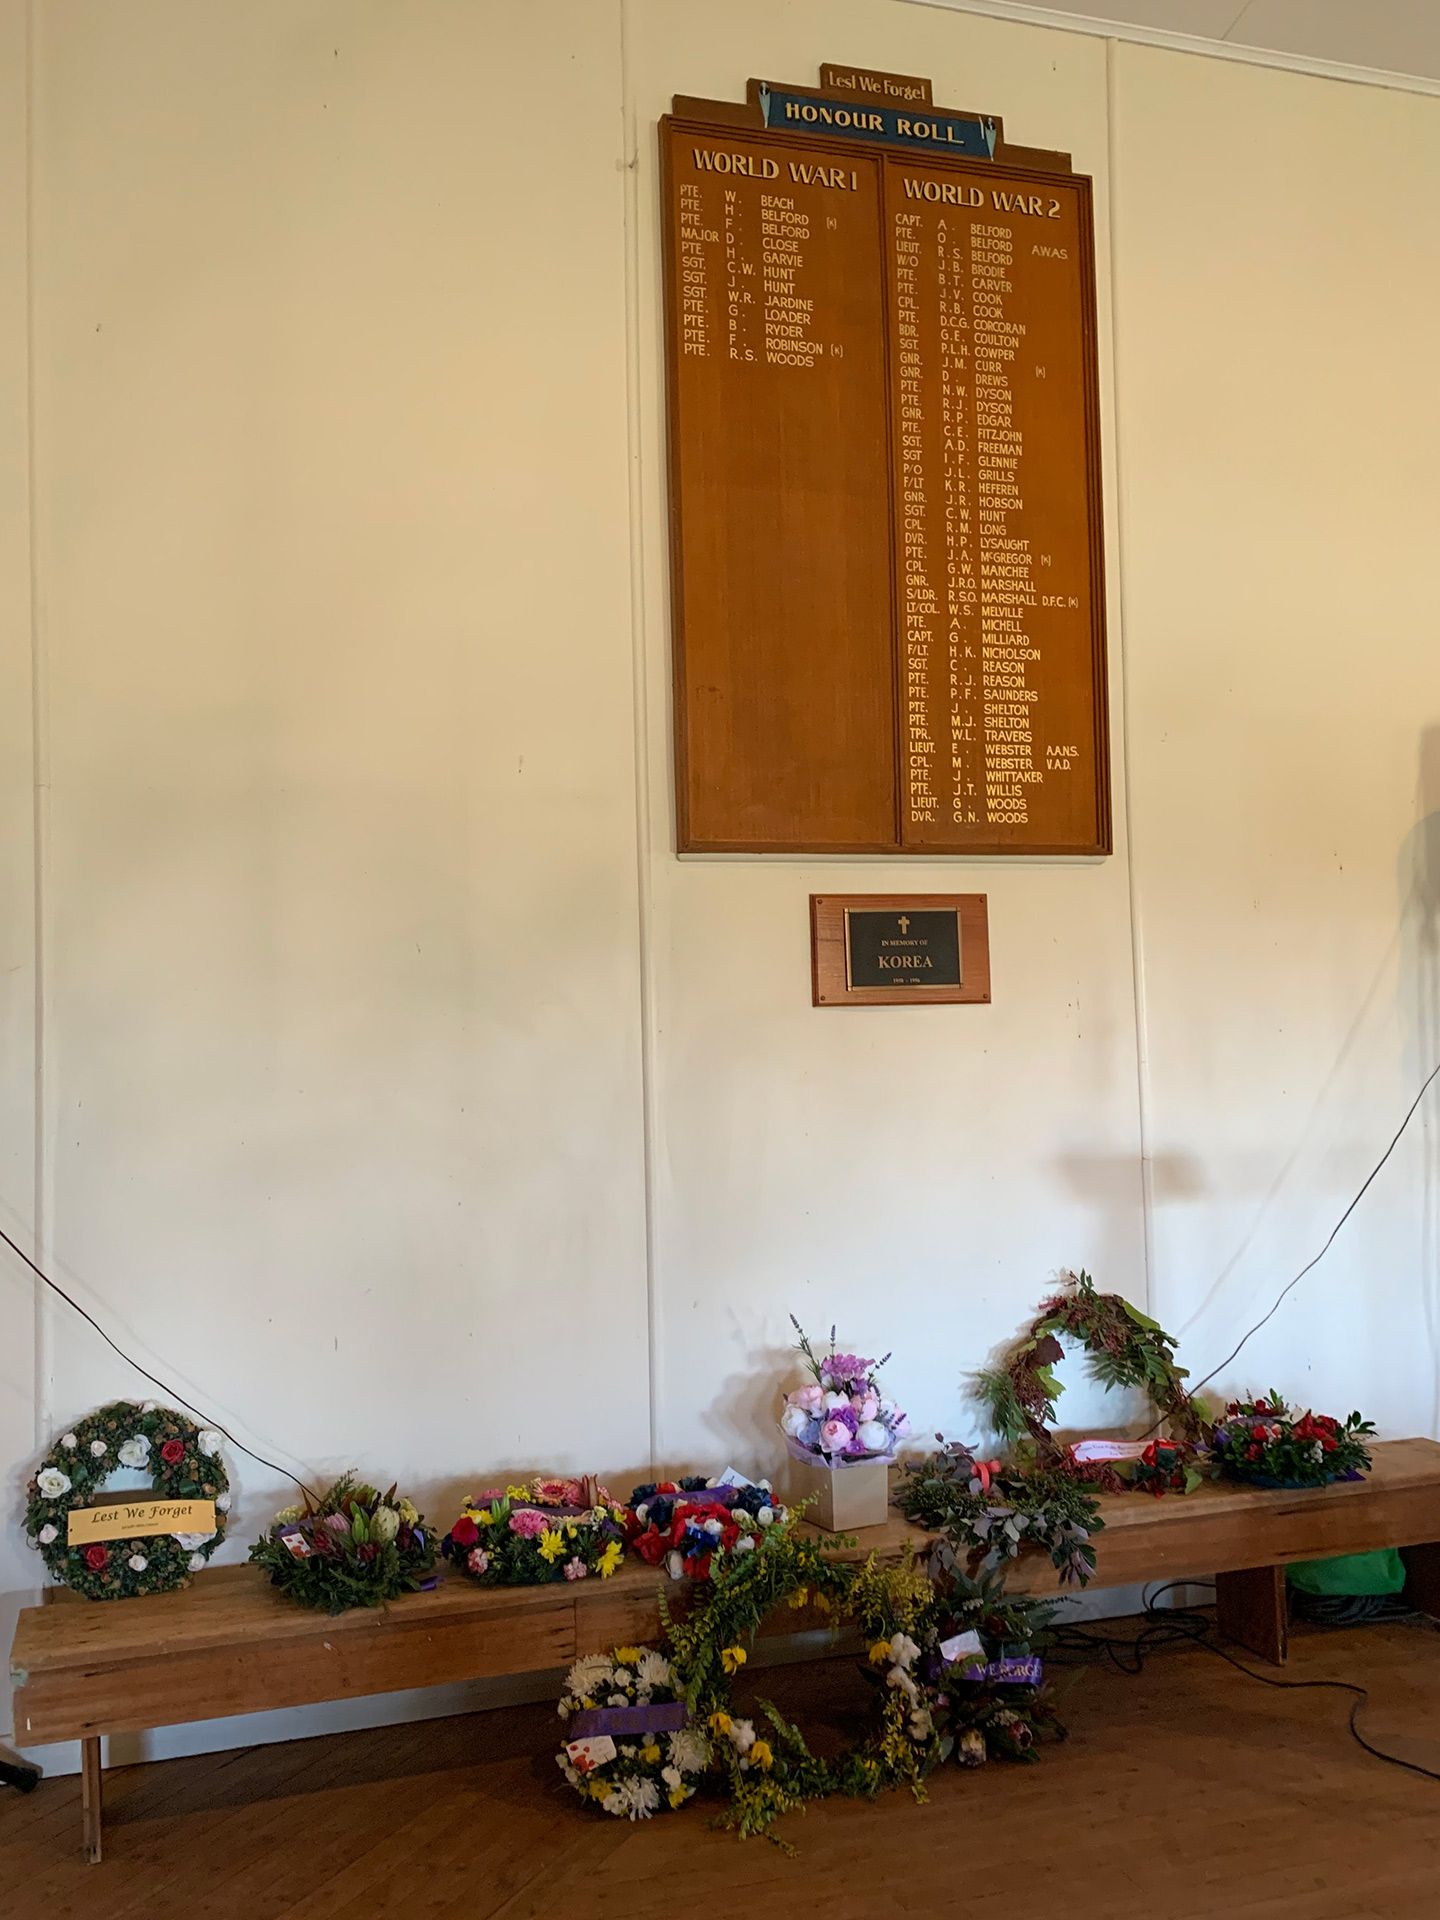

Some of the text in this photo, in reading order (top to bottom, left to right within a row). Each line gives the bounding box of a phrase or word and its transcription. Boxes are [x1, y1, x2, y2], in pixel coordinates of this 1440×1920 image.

[828, 71, 926, 101] Lest We Forget
[785, 101, 965, 145] HONOUR ROLL
[693, 148, 779, 180] WORLD
[789, 162, 846, 190] WAR
[760, 194, 794, 210] BEACH
[903, 178, 1061, 219] WORLD WAR 2
[761, 209, 809, 225] BELFORD
[762, 223, 810, 240] BELFORD
[970, 223, 1012, 239] BELFORD
[681, 227, 799, 253] MAJOR CLOSE
[971, 236, 1013, 252] BELFORD
[763, 252, 803, 268] GARVIE
[971, 250, 1013, 265] BELFORD
[763, 266, 795, 280] HUNT
[897, 254, 1006, 279] W/O BRODIE
[764, 280, 796, 295] HUNT
[972, 277, 1013, 293] CARVER
[765, 296, 814, 311] JARDINE
[973, 292, 1003, 306] COOK
[765, 309, 811, 325] LOADER
[973, 305, 1003, 319] COOK
[765, 323, 804, 338] RYDER
[973, 319, 1026, 335] CORCORAN
[766, 337, 823, 355] ROBINSON
[974, 333, 1019, 348] COULTON
[766, 352, 814, 367] WOODS
[975, 347, 1015, 361] COWPER
[975, 360, 1002, 373] CURR
[975, 373, 1008, 387] DREWS
[975, 387, 1012, 401] DYSON
[976, 402, 1012, 415] DYSON
[977, 414, 1012, 428] EDGAR
[977, 428, 1022, 442] FITZJOHN
[978, 442, 1022, 456] FREEMAN
[903, 449, 1018, 469] SGT GLENNIE
[903, 464, 1015, 482] P/O GRILLS
[903, 476, 1019, 496] F/LT HEFEREN
[979, 497, 1023, 510] HOBSON
[979, 510, 1006, 523] HUNT
[980, 523, 1007, 536] LONG
[980, 537, 1029, 551] LYSAUGHT
[980, 551, 1032, 565] McGREGOR
[981, 565, 1029, 579] MANCHEE
[981, 578, 1036, 593] MARSHALL
[981, 592, 1037, 606] MARSHALL
[981, 606, 1024, 619] MELVILLE
[982, 619, 1022, 633] MICHELL
[982, 634, 1029, 646] MILLIARD
[982, 647, 1040, 661] NICHOLSON
[983, 661, 1025, 674] REASON
[983, 675, 1025, 688] REASON
[983, 689, 1038, 702] SAUNDERS
[984, 704, 1029, 716] SHELTON
[984, 716, 1029, 729] SHELTON
[984, 730, 1032, 743] TRAVERS
[985, 744, 1032, 756] WEBSTER
[985, 758, 1033, 770] WEBSTER
[986, 771, 1043, 784] WHITTAKER
[986, 784, 1022, 797] WILLIS
[986, 799, 1027, 810] WOODS
[987, 812, 1029, 824] WOODS
[878, 955, 933, 969] KOREA
[91, 1505, 193, 1524] Lest We Forget
